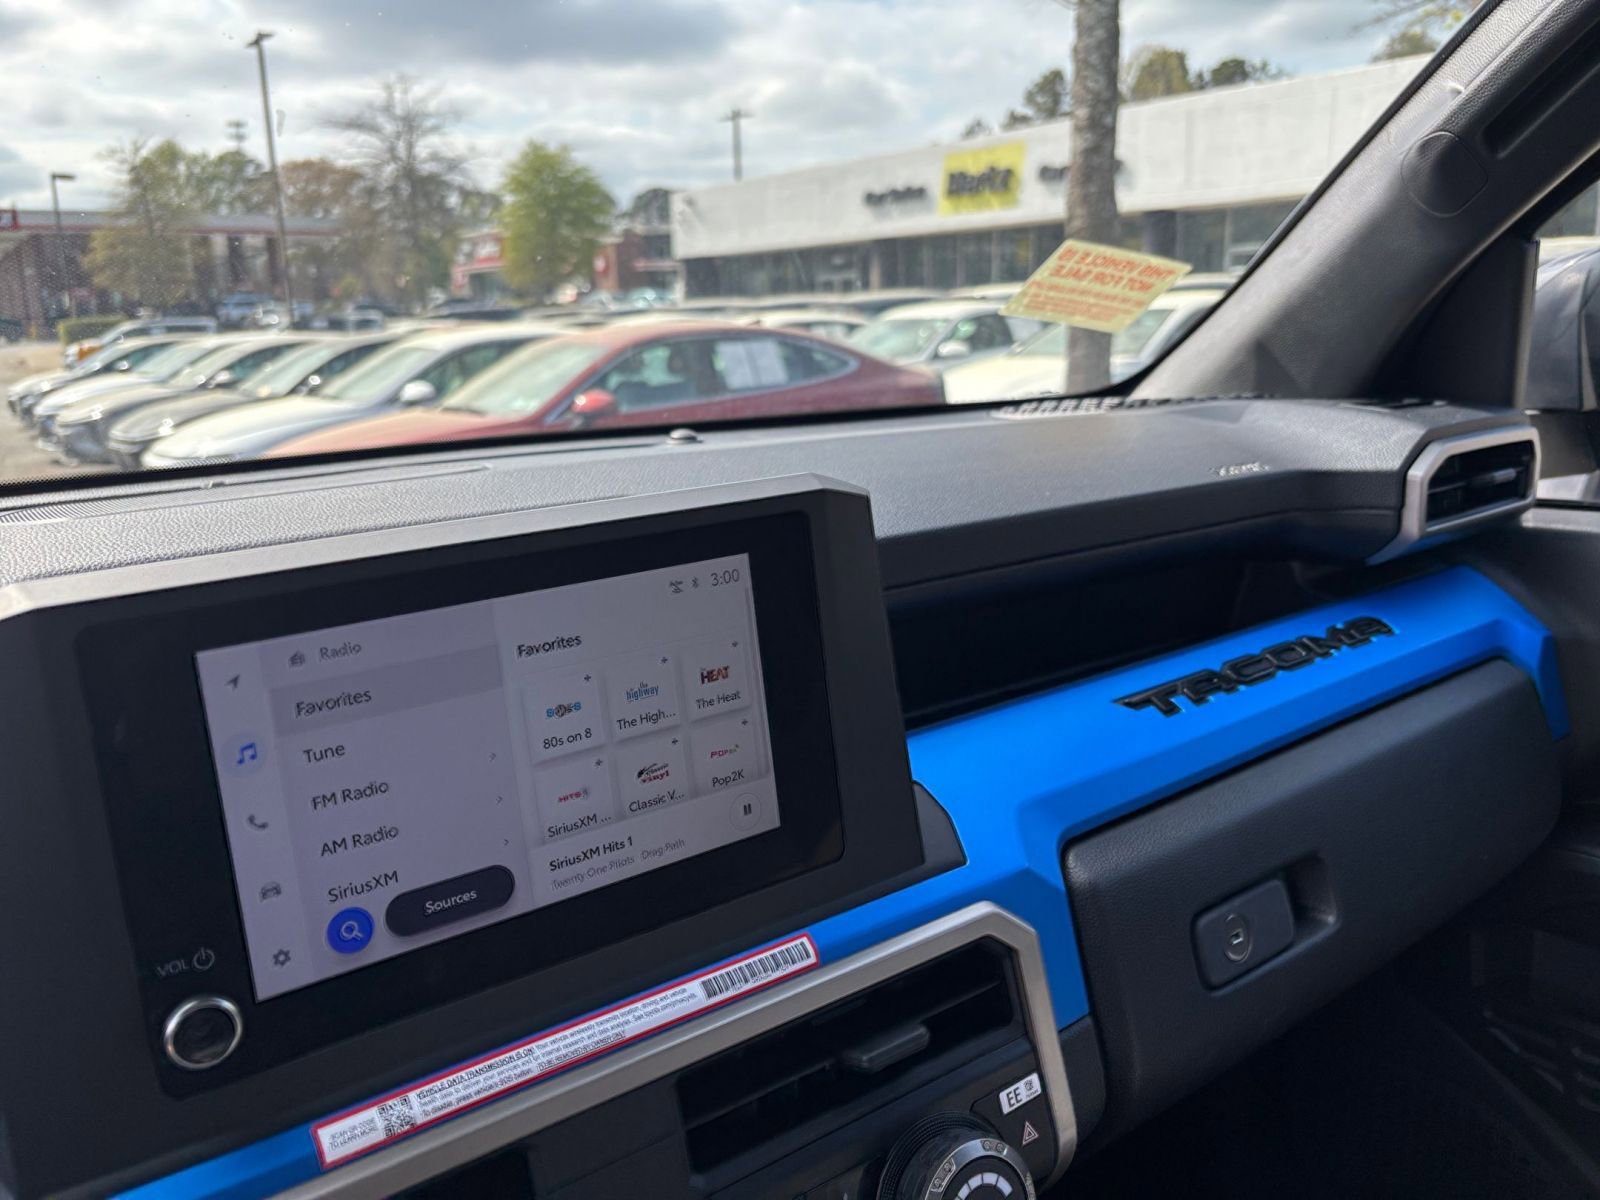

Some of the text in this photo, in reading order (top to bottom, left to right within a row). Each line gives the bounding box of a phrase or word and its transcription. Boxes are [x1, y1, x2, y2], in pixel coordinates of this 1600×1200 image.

[710, 568, 741, 587] 3:00
[318, 642, 362, 662] Radio
[516, 633, 583, 658] Favorites
[700, 665, 729, 685] HEAT
[1113, 616, 1398, 718] TACOMA
[294, 689, 373, 718] Favorites
[696, 690, 742, 710] The Heat
[616, 709, 677, 730] The High...
[543, 727, 593, 749] 80s on 8
[302, 744, 346, 763] Tune
[712, 769, 745, 787] Pop2K
[311, 781, 390, 810] FM Radio
[628, 794, 667, 812] Classic
[547, 813, 598, 838] SiriusXM
[320, 826, 400, 857] AM Radio
[549, 836, 633, 872] SiriusXM Hits 1
[327, 870, 400, 903] SiriusXM
[423, 889, 478, 915] Sources
[156, 960, 189, 977] VOL
